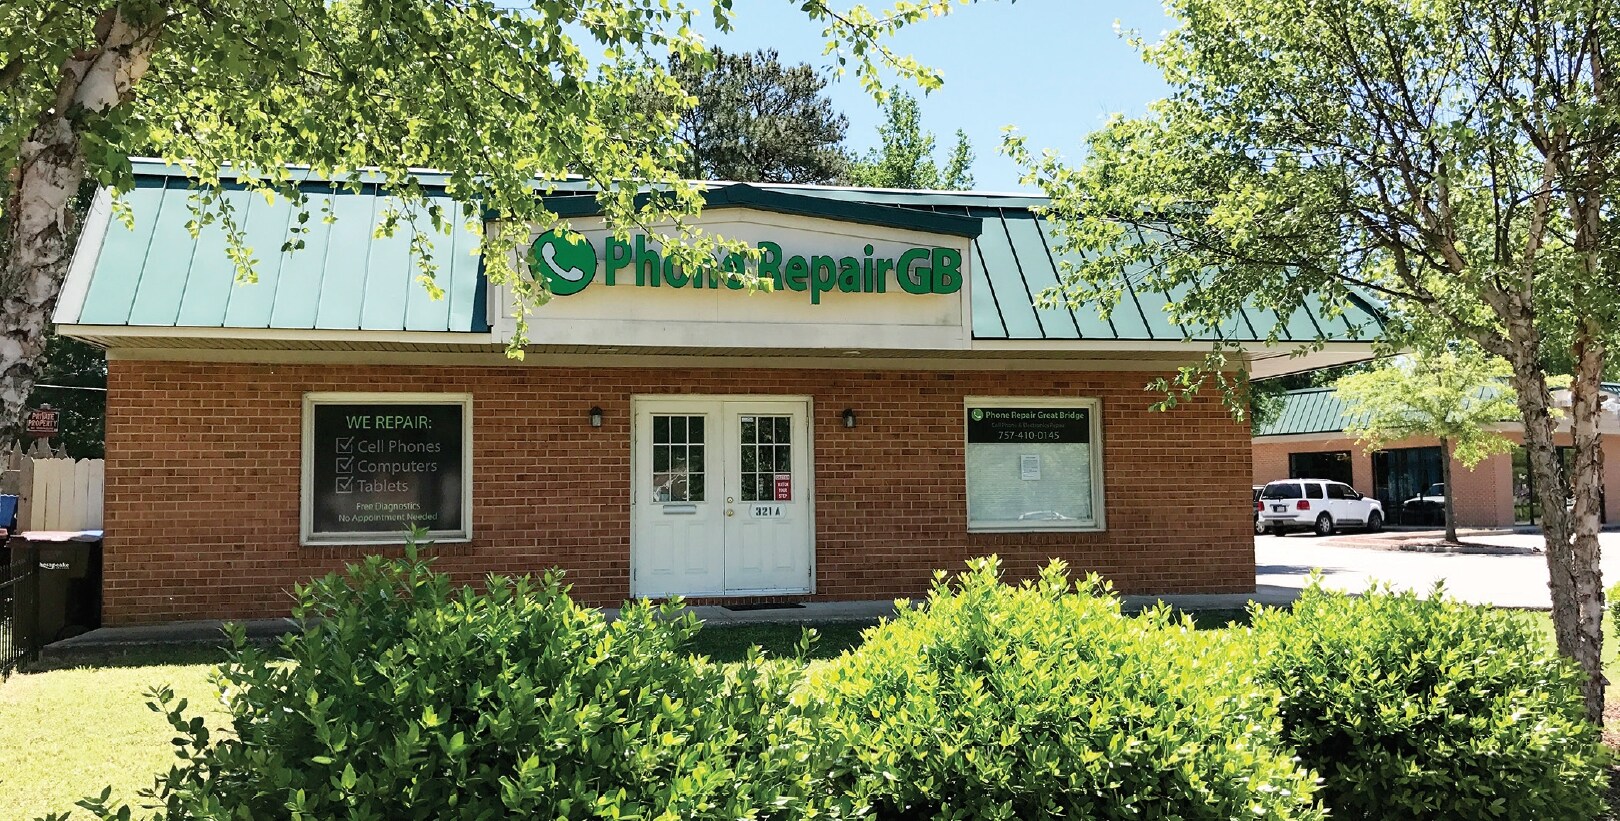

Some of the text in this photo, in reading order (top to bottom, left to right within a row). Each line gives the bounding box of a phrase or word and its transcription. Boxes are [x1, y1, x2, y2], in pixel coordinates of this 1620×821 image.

[31, 411, 55, 420] PRIVATE
[985, 411, 1084, 420] Phone Repair Great Bridge
[29, 419, 58, 427] PROPERTY
[346, 415, 432, 429] WE REPAIR:
[998, 431, 1060, 439] 757-410-0145
[357, 440, 441, 453] Cell Phones
[357, 460, 438, 475] Computers
[357, 479, 409, 492] Tablets
[356, 502, 421, 512] Free Diagnostics
[755, 506, 781, 516] 321 A
[338, 512, 438, 523] No Appointment Needed
